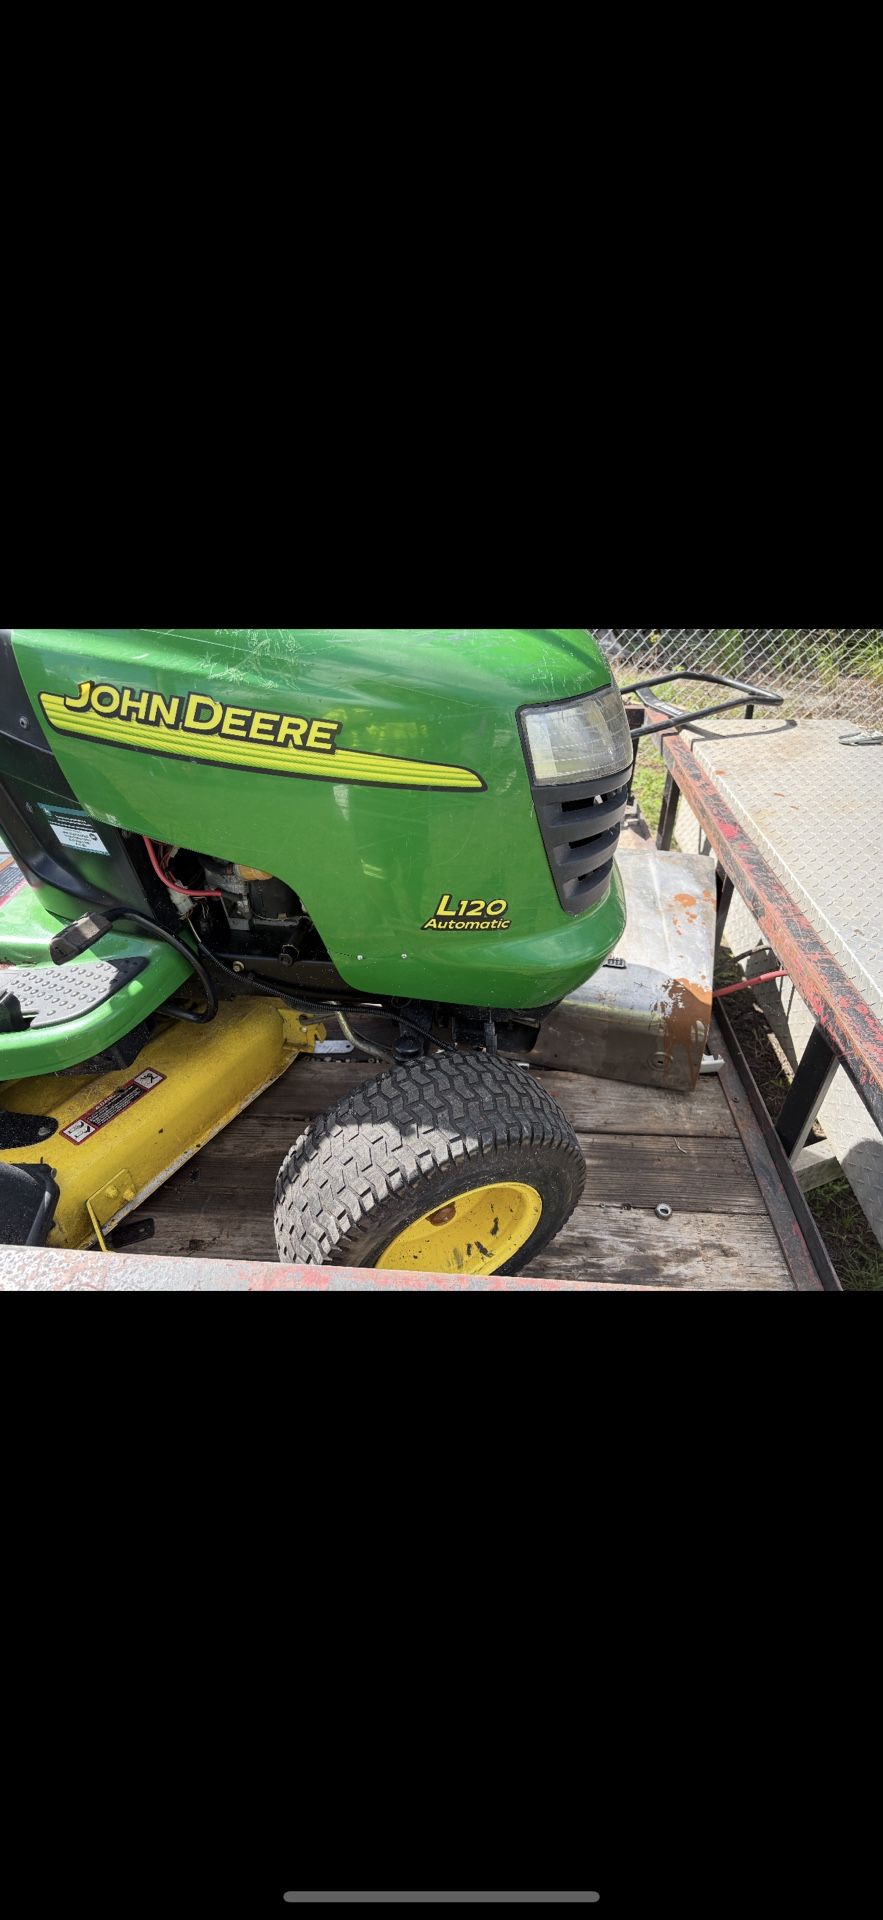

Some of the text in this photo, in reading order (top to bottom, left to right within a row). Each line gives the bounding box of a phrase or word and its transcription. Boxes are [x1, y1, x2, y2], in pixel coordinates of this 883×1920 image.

[65, 681, 339, 750] JOHN DEERE
[436, 894, 507, 916] L120
[423, 917, 511, 930] Automatic
